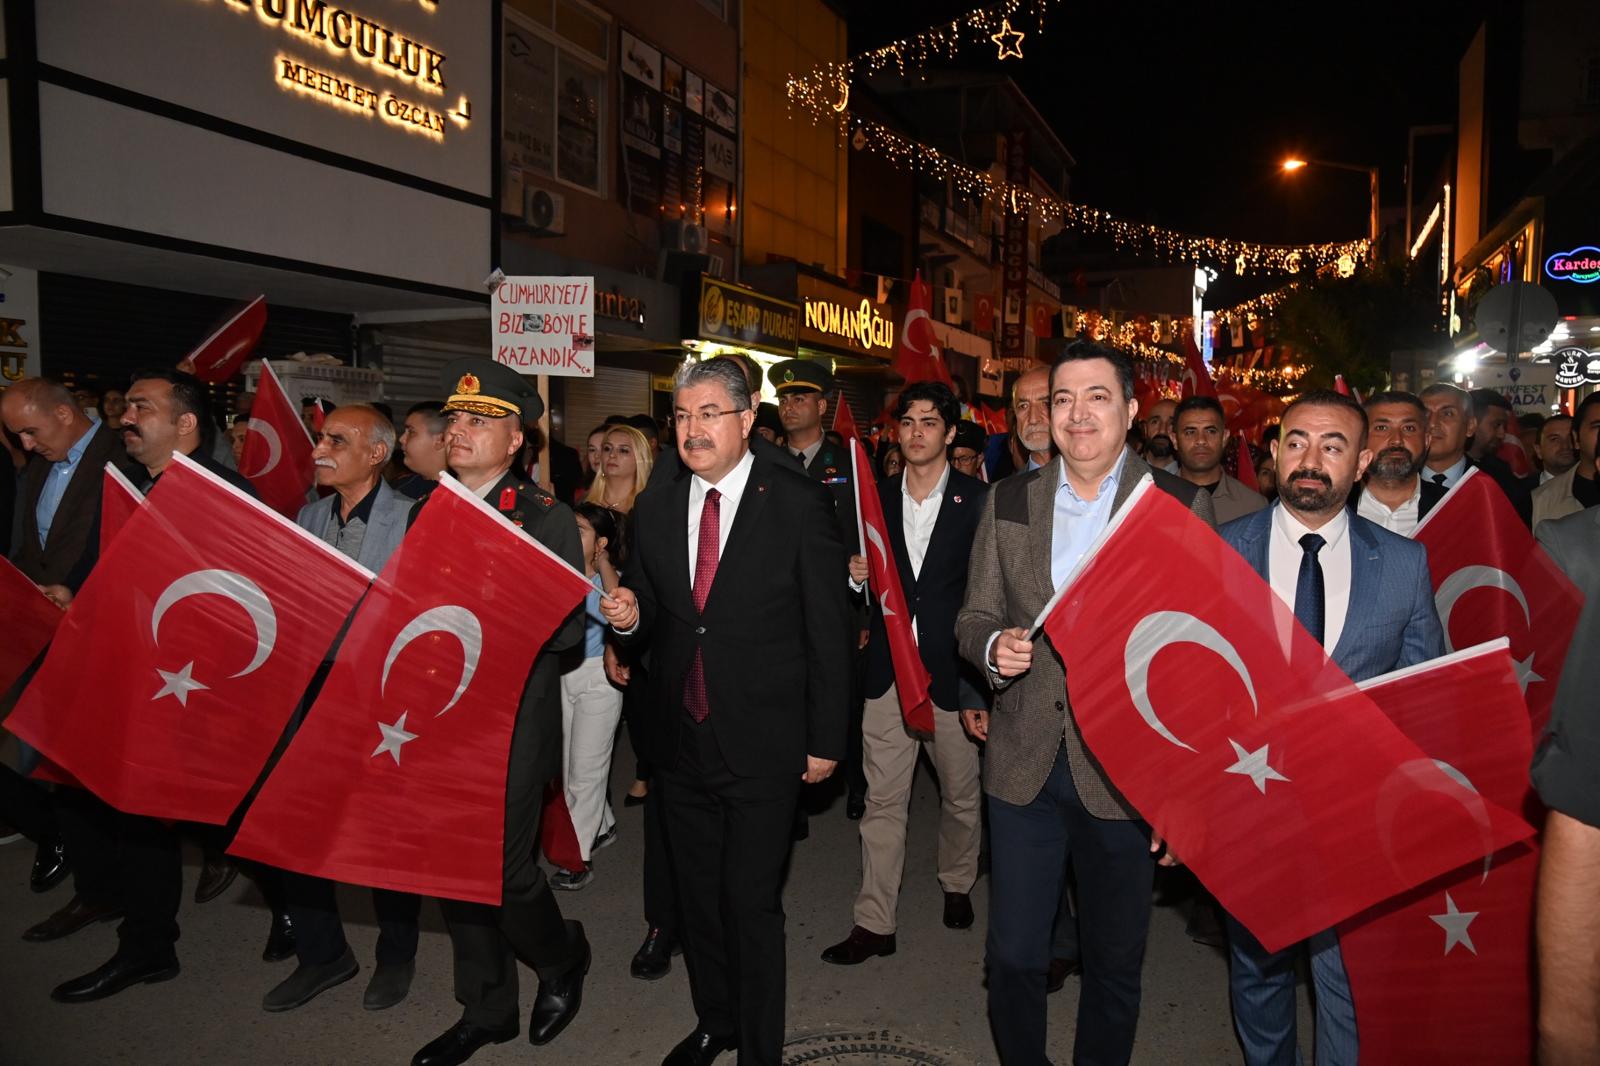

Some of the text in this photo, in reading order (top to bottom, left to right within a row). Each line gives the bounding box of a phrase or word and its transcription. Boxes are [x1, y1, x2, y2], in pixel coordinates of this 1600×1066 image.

[281, 59, 446, 134] MEHMET ÖZCAN
[543, 312, 588, 336] BÖYLE
[726, 299, 761, 335] EŞARP
[762, 308, 796, 342] DURAĞI
[805, 298, 894, 350] NOMANOĞLU
[498, 346, 581, 370] KAZANDIK
